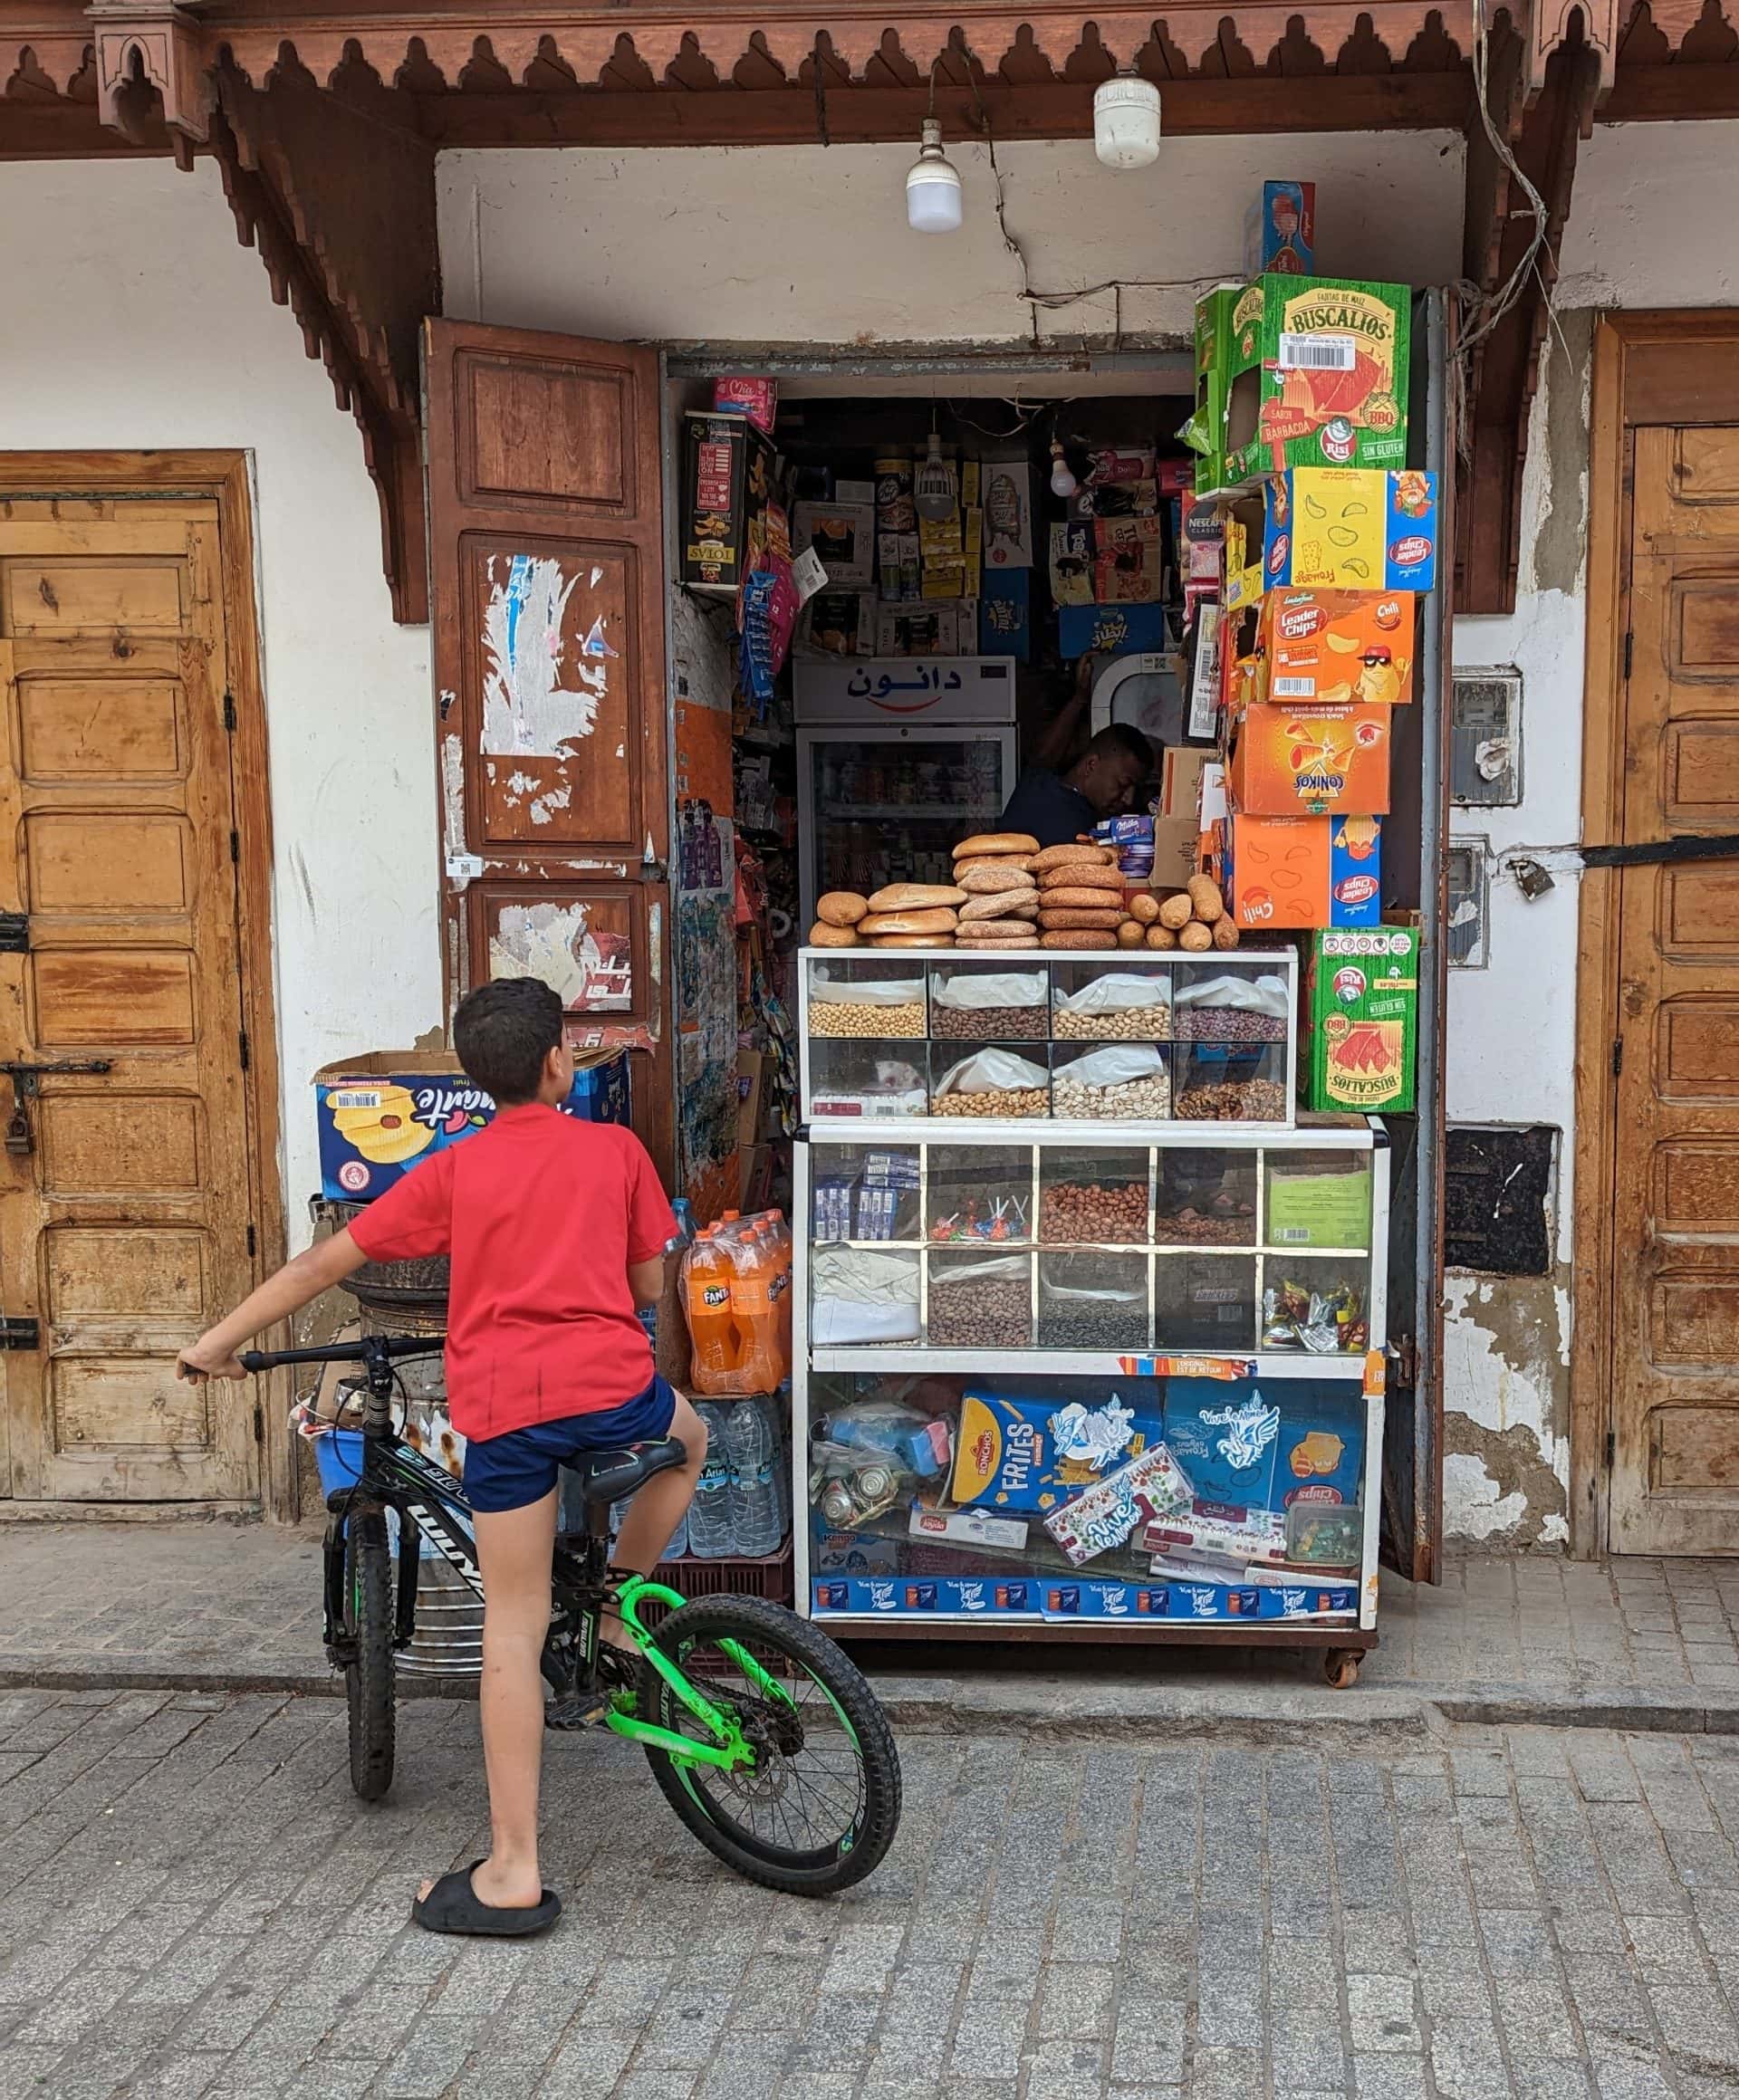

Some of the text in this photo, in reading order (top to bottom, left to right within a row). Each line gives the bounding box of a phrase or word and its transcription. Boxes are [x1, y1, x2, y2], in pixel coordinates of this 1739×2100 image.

[1291, 307, 1389, 340] BUSCALIOS
[1369, 410, 1394, 426] BBQ
[1265, 420, 1311, 441] BARBACOA
[1327, 443, 1350, 458] Risi
[1362, 441, 1404, 457] SIN GLUTEN
[1398, 540, 1425, 551] Chips
[689, 548, 733, 561] TOTAS
[1397, 549, 1427, 562] Leader
[1294, 568, 1335, 585] Fromage
[1282, 609, 1320, 627] Leader
[1377, 601, 1399, 618] Chili
[1285, 619, 1318, 637] Chips
[847, 666, 962, 698] دانون
[1116, 819, 1139, 832] Milka
[1343, 877, 1370, 891] Chips
[1341, 886, 1372, 901] Leader
[1244, 901, 1273, 924] Chili
[453, 1079, 470, 1087] fruit
[1331, 1075, 1398, 1092] BUSCALIOS
[979, 1430, 993, 1476] RONCHOS
[1002, 1424, 1034, 1490] FRITES
[1298, 1488, 1332, 1501] Chips
[1088, 1492, 1132, 1537] Vive
